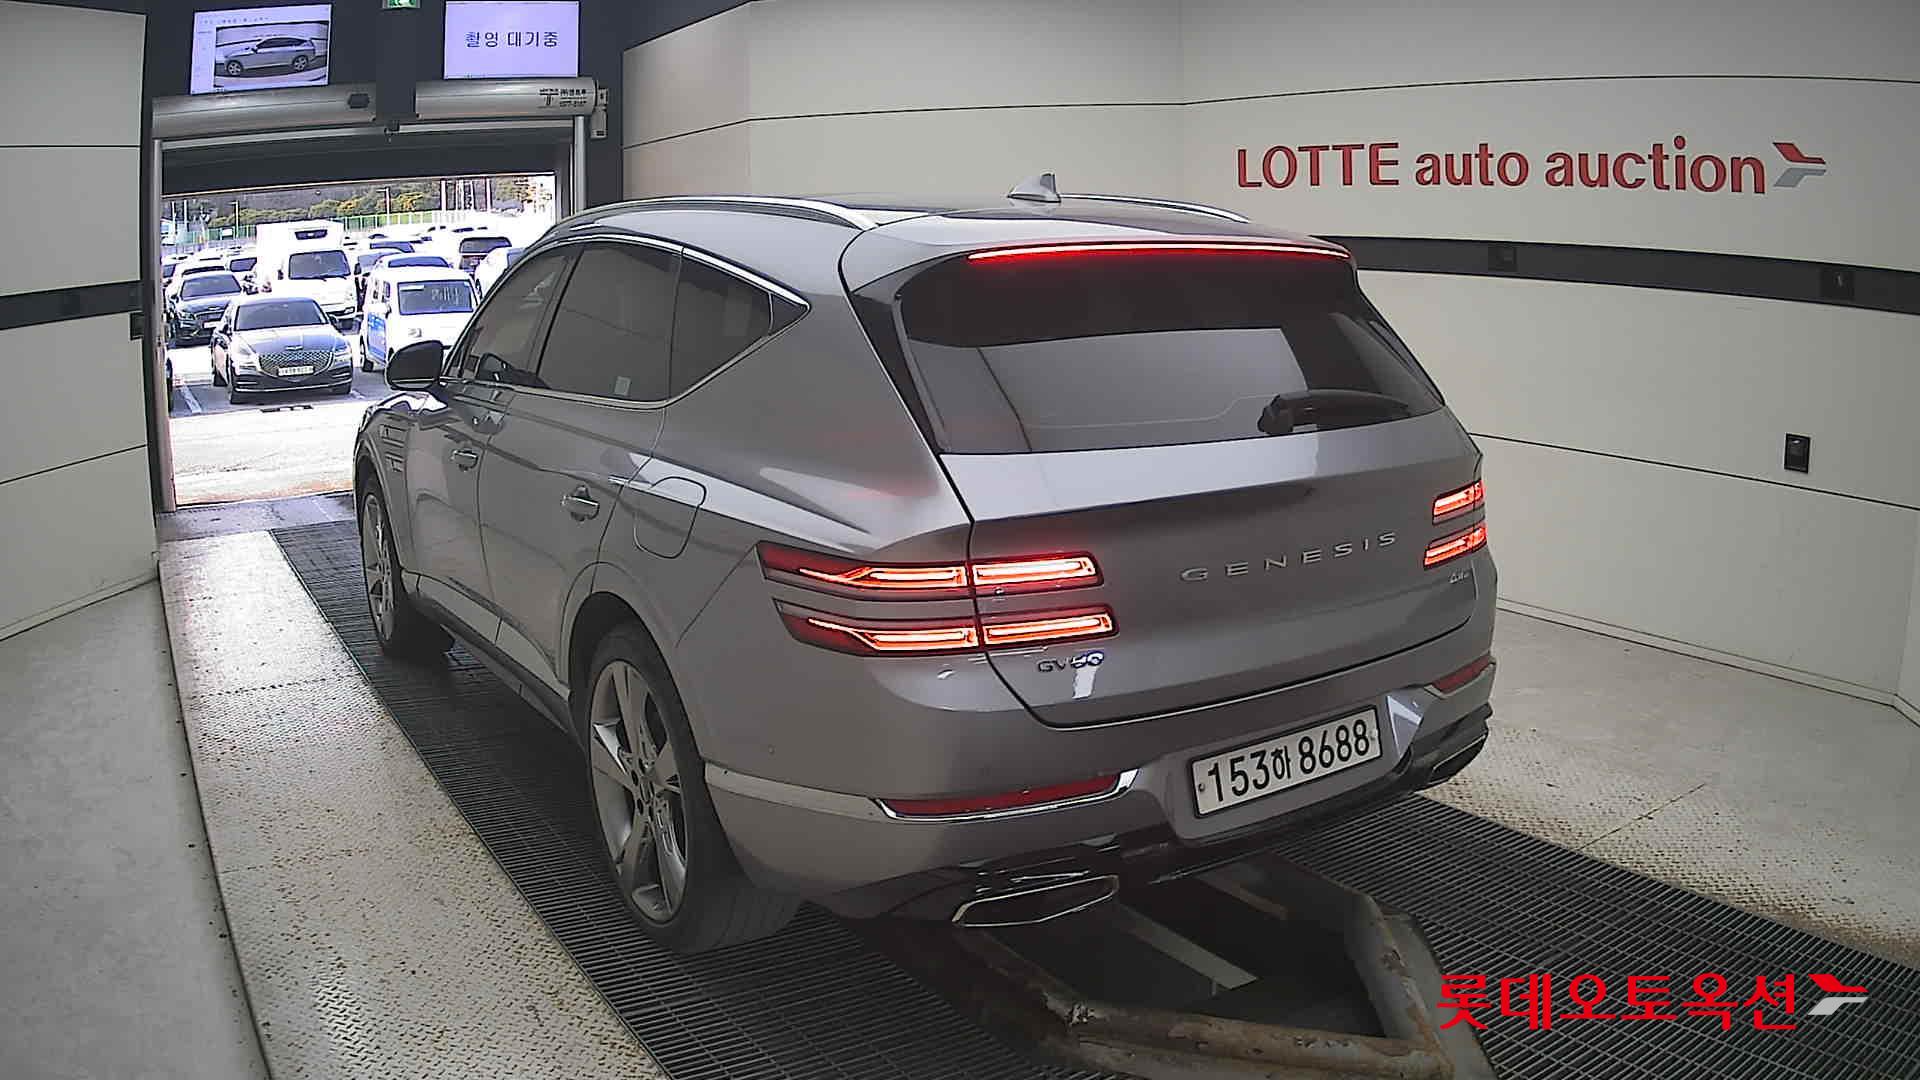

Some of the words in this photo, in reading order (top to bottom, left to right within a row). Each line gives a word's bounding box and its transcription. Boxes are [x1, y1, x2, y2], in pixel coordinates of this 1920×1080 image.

[507, 31, 558, 48] 대기중
[1237, 142, 1399, 188] LOTTE
[1415, 142, 1529, 187] auto
[1545, 135, 1766, 195] auction
[1180, 531, 1397, 582] GENESIS
[1298, 719, 1370, 775] 8688
